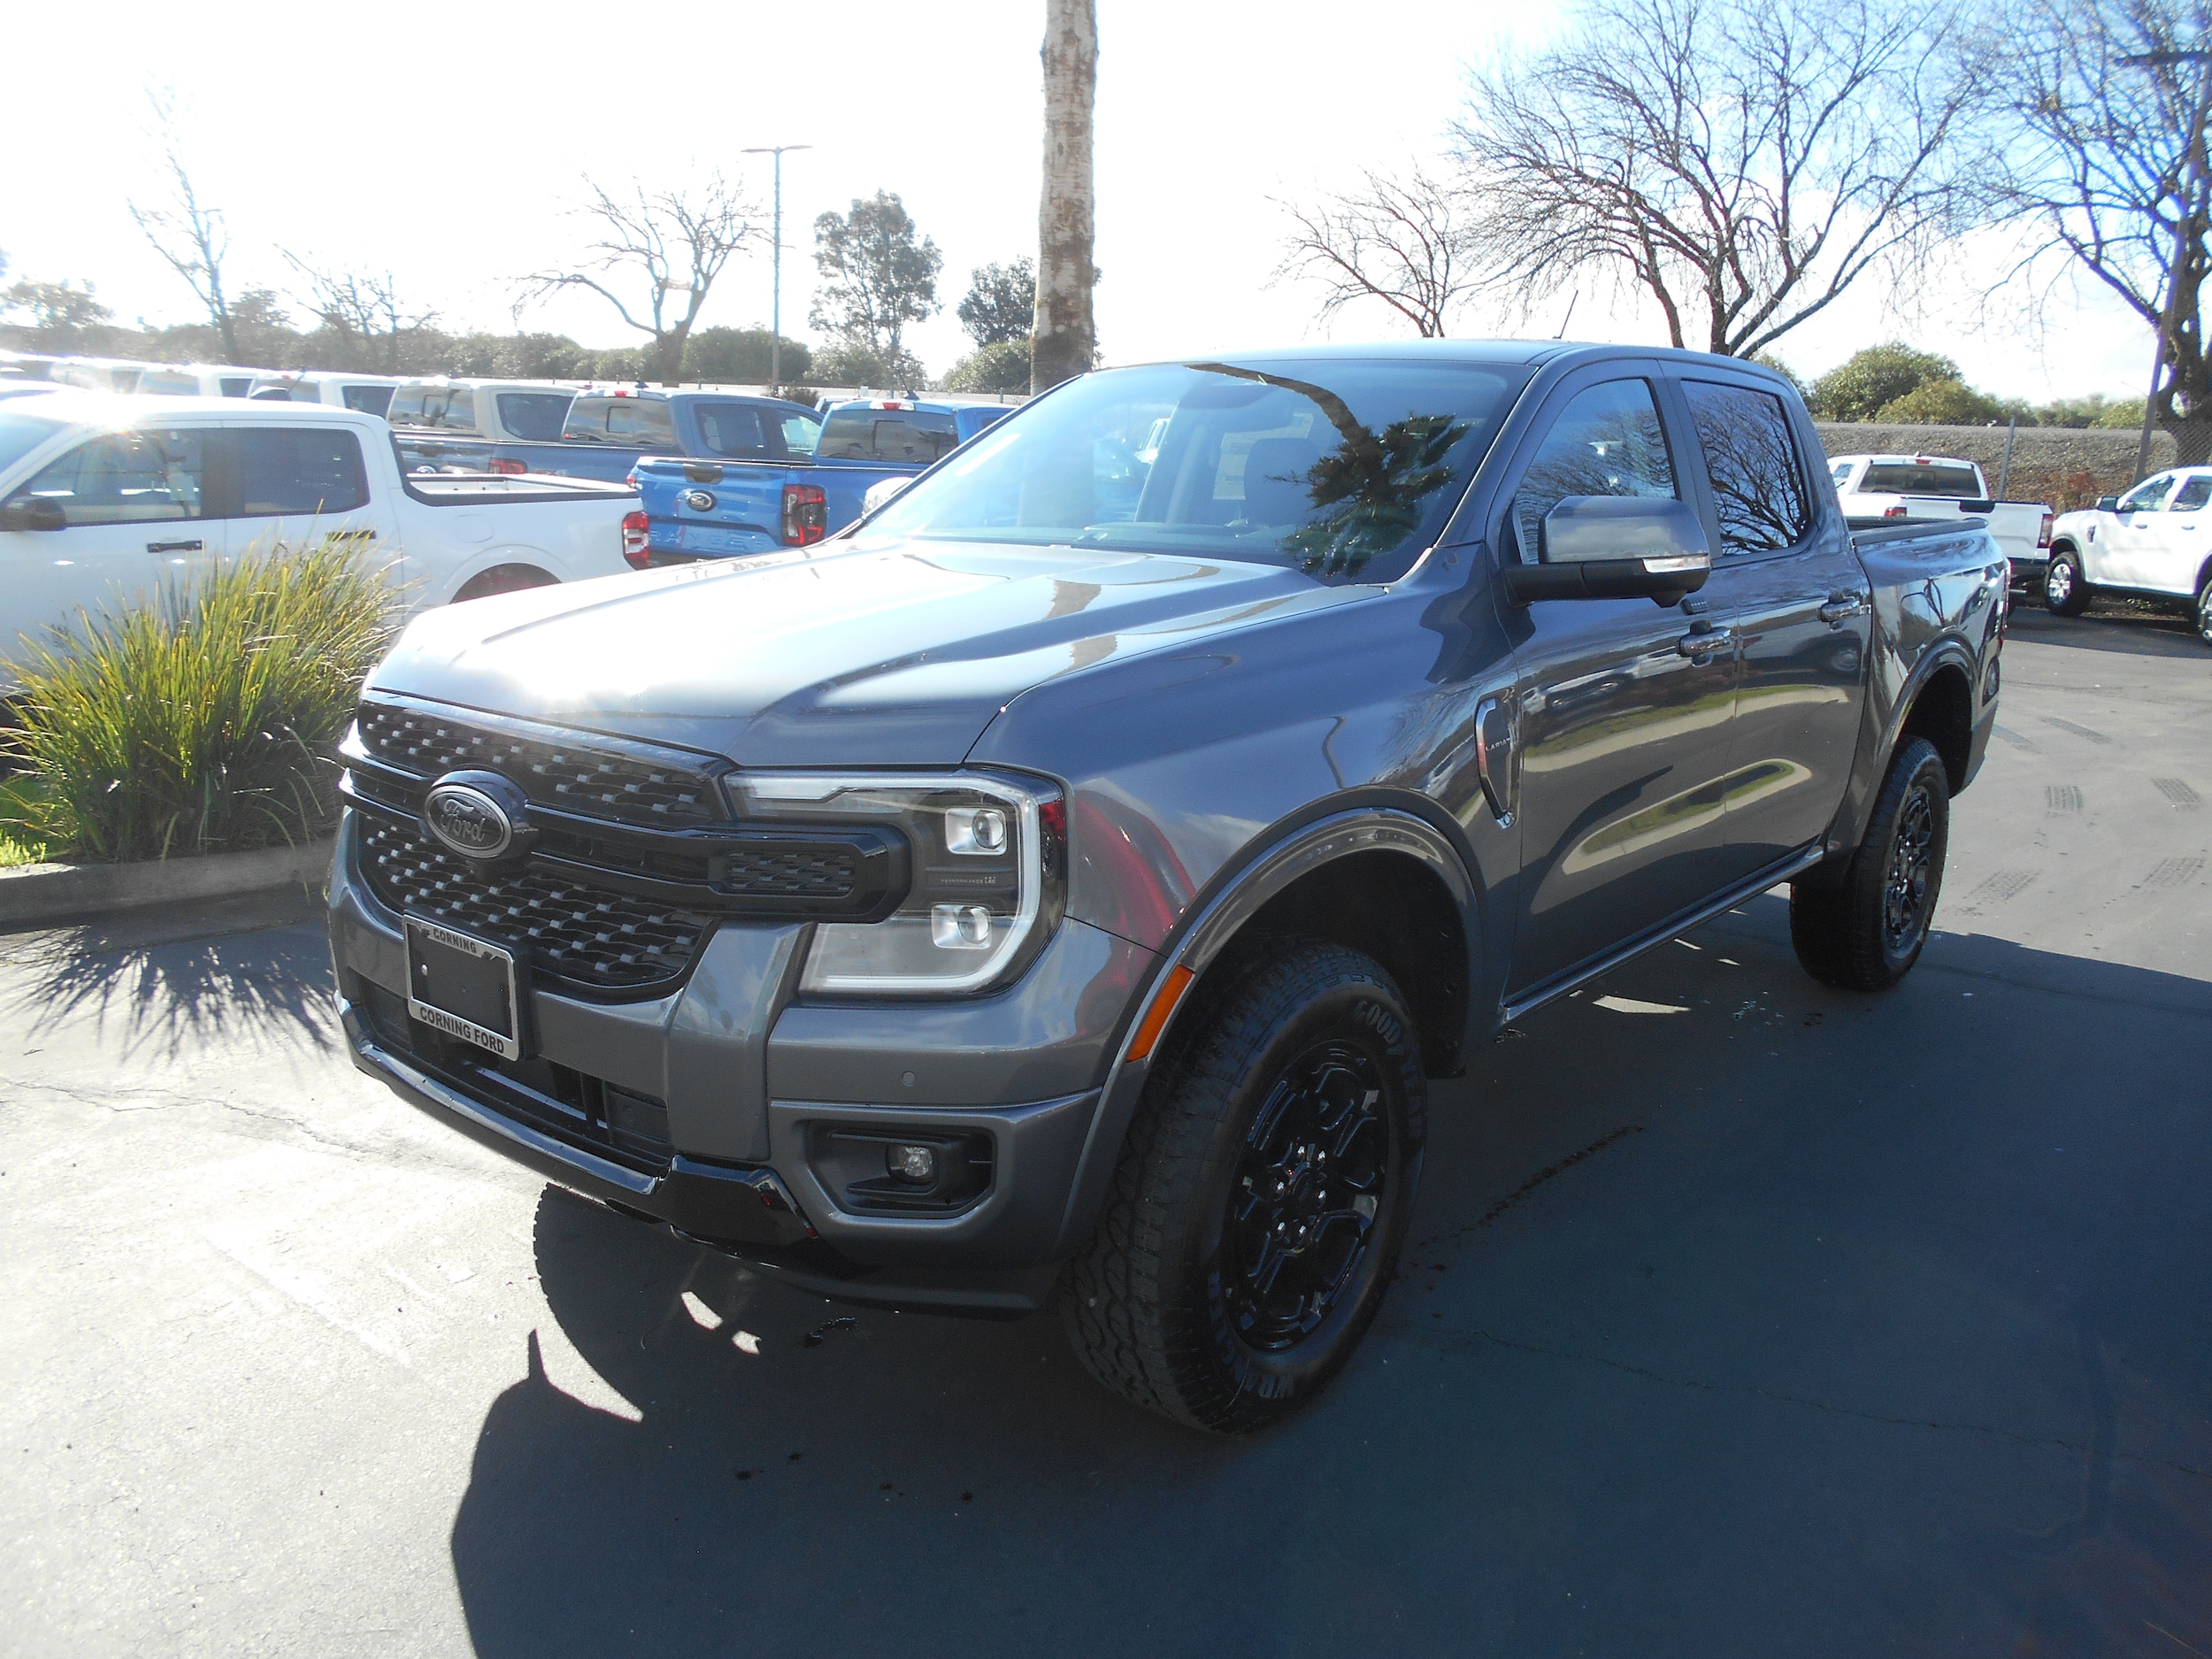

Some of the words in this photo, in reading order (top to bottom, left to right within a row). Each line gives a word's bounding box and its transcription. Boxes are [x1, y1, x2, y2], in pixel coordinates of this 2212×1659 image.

[649, 529, 767, 550] RANGER
[1486, 737, 1511, 751] LARIAT
[442, 799, 486, 841] Ford
[434, 927, 477, 954] CORNING
[420, 1007, 471, 1039] CORNING
[474, 1028, 504, 1054] FORD
